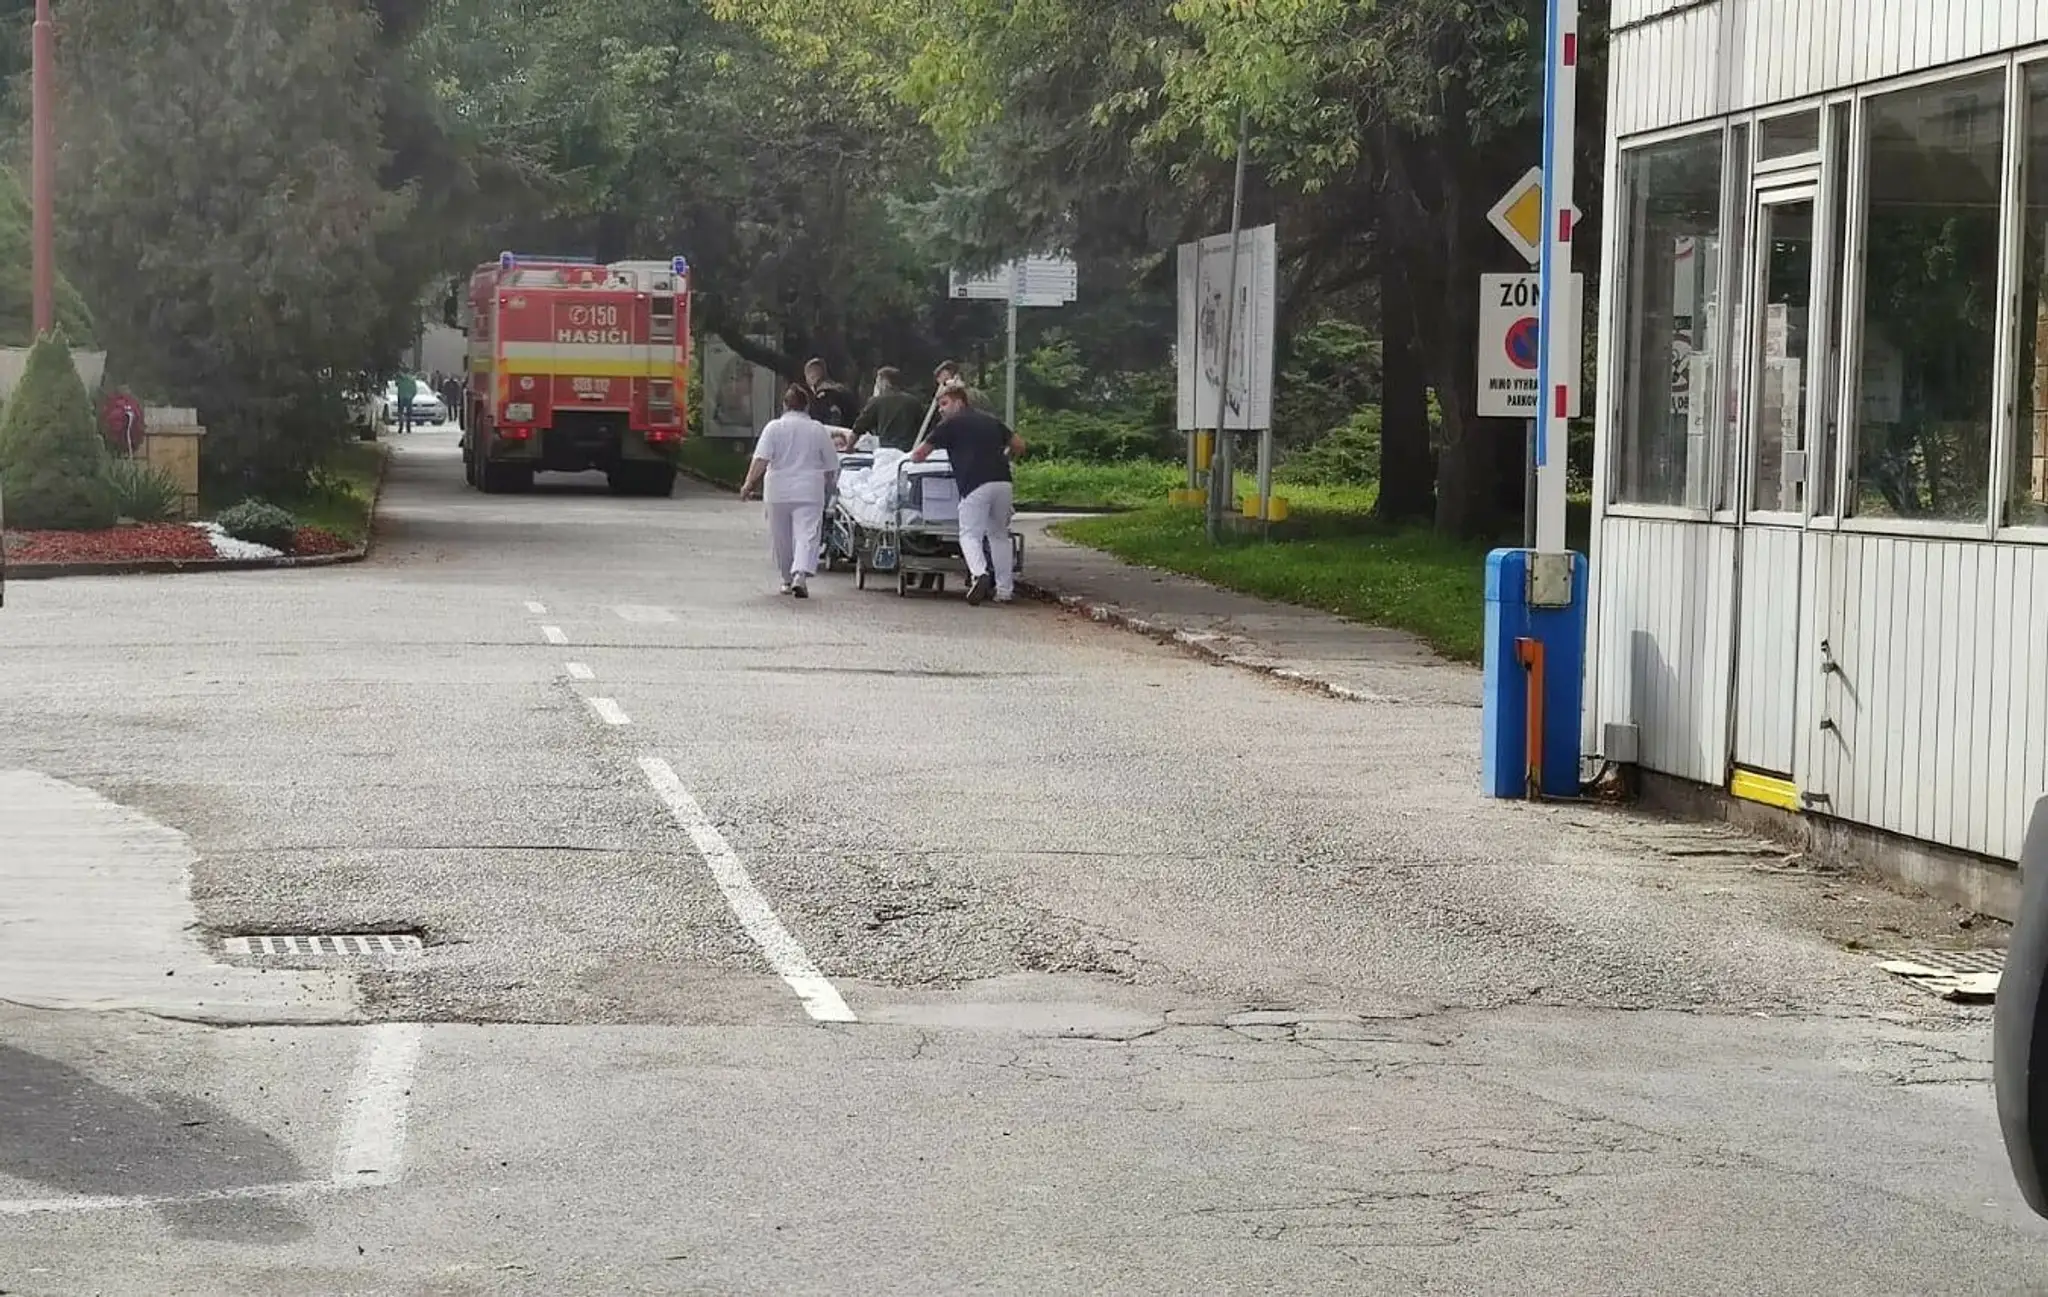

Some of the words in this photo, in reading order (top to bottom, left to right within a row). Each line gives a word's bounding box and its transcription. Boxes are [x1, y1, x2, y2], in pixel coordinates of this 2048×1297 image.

[1500, 277, 1540, 307] ZÓN
[589, 305, 617, 326] 150
[558, 327, 628, 344] HASIČI
[1513, 378, 1538, 390] VYHRA
[1507, 394, 1538, 406] PARKOV
